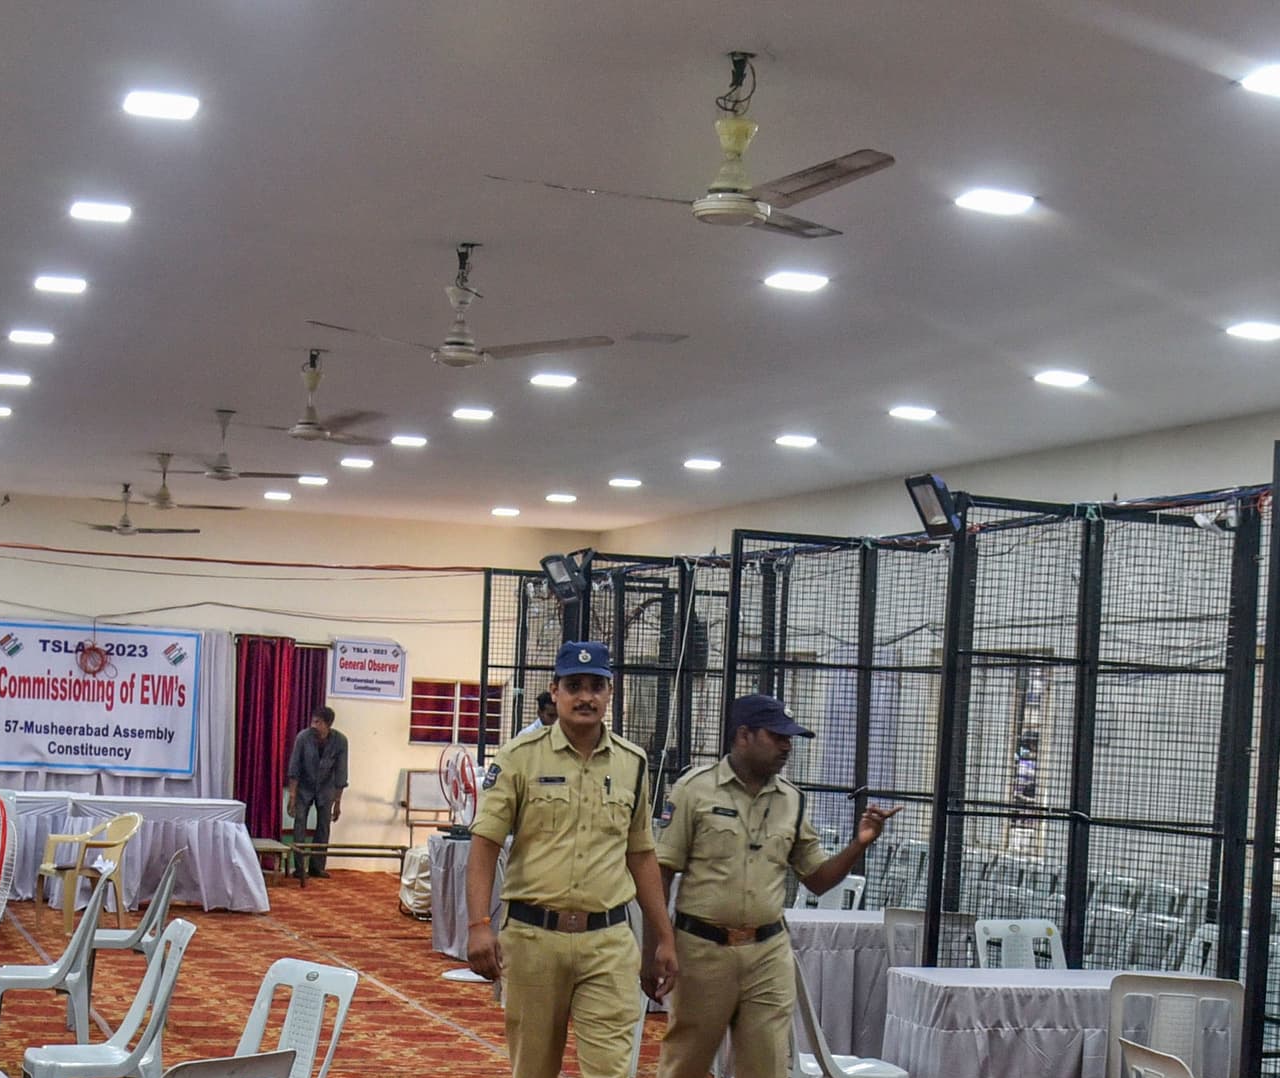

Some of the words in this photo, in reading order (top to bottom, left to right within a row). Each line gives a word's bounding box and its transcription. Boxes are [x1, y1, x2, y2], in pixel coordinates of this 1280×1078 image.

[38, 639, 86, 654] TSLA
[104, 643, 149, 658] 2023
[339, 657, 366, 670] General
[367, 659, 399, 672] Observer
[120, 673, 136, 704] of
[140, 674, 186, 707] EVM's
[4, 720, 110, 738] 57-Musheerabad
[113, 724, 176, 744] Assembly
[47, 741, 132, 760] Constituency
